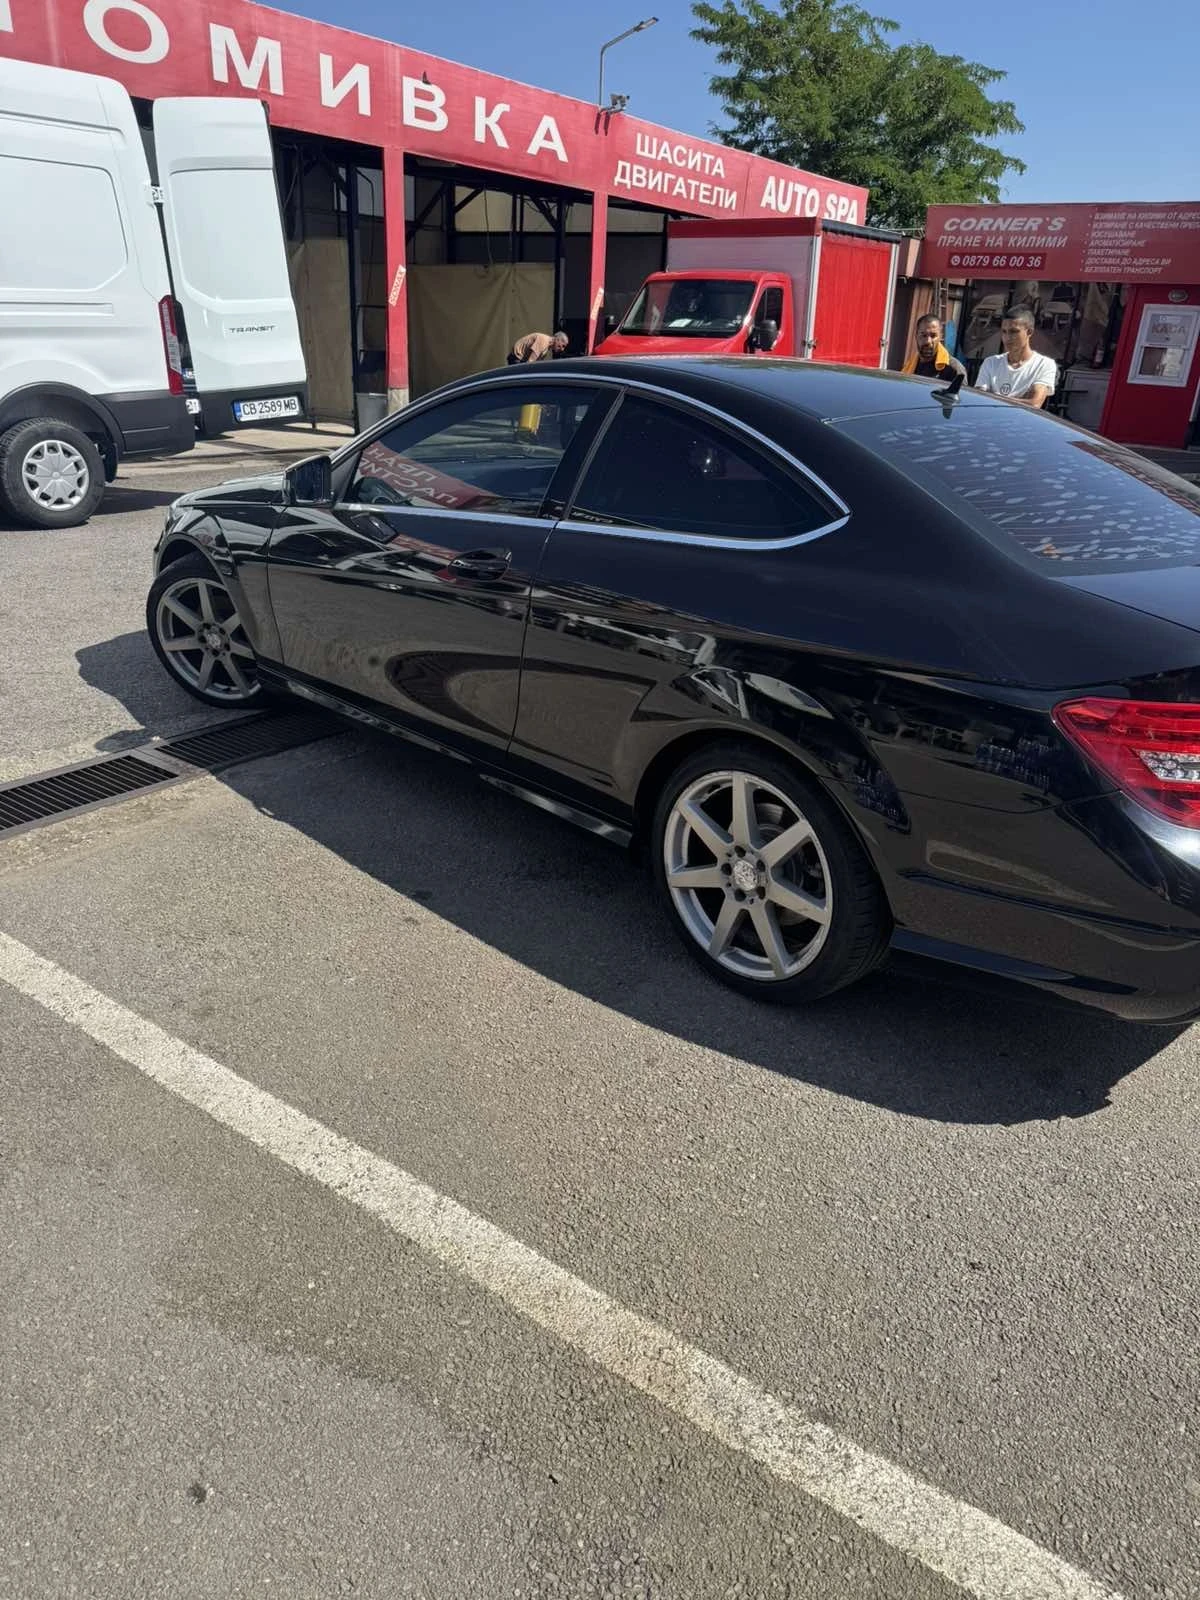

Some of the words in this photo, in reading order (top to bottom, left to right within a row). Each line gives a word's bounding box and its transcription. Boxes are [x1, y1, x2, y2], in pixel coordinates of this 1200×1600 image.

[0, 0, 569, 163] ОМИВКА
[635, 132, 726, 179] ШАСИТА
[613, 160, 738, 211] ДВИГАТЕЛИ
[760, 175, 820, 218] AUTO
[824, 193, 860, 225] SPA
[943, 216, 1067, 231] CORNER'S
[936, 235, 982, 248] ПРАНЕ
[984, 235, 1004, 248] НА
[1007, 235, 1068, 248] КИЛИМИ
[962, 255, 990, 267] 0879
[992, 255, 1007, 267] 66
[1008, 255, 1025, 268] 00
[1026, 256, 1042, 268] 36
[1120, 257, 1132, 265] ДО
[229, 325, 276, 333] TRANSIT
[242, 403, 257, 415] CB
[258, 401, 282, 413] 2589
[283, 399, 297, 410] MB
